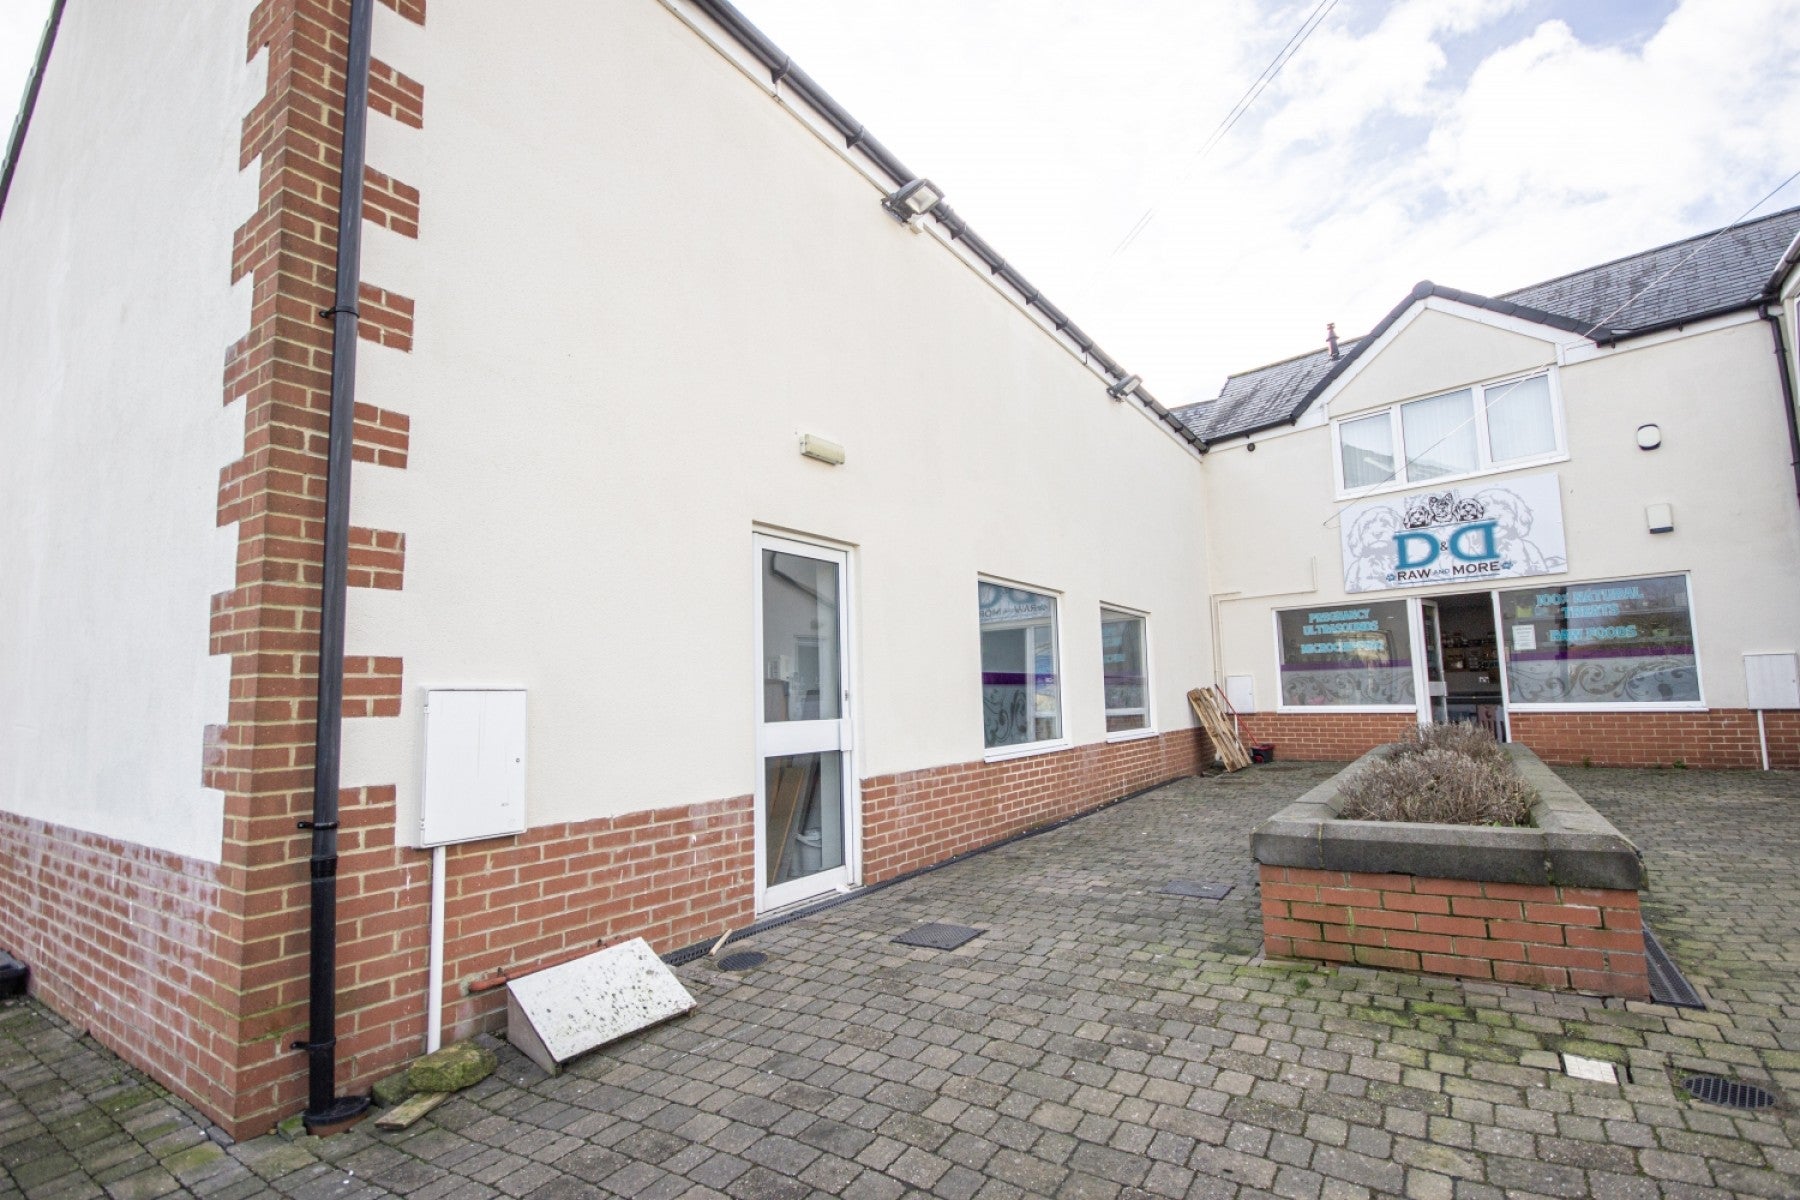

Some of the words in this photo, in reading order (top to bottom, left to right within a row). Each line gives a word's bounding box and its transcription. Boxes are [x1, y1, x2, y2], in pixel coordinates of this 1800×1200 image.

[1397, 568, 1431, 581] RAW
[1453, 561, 1500, 576] MORE
[1573, 586, 1643, 602] NATURAL
[1586, 625, 1637, 640] FOODS
